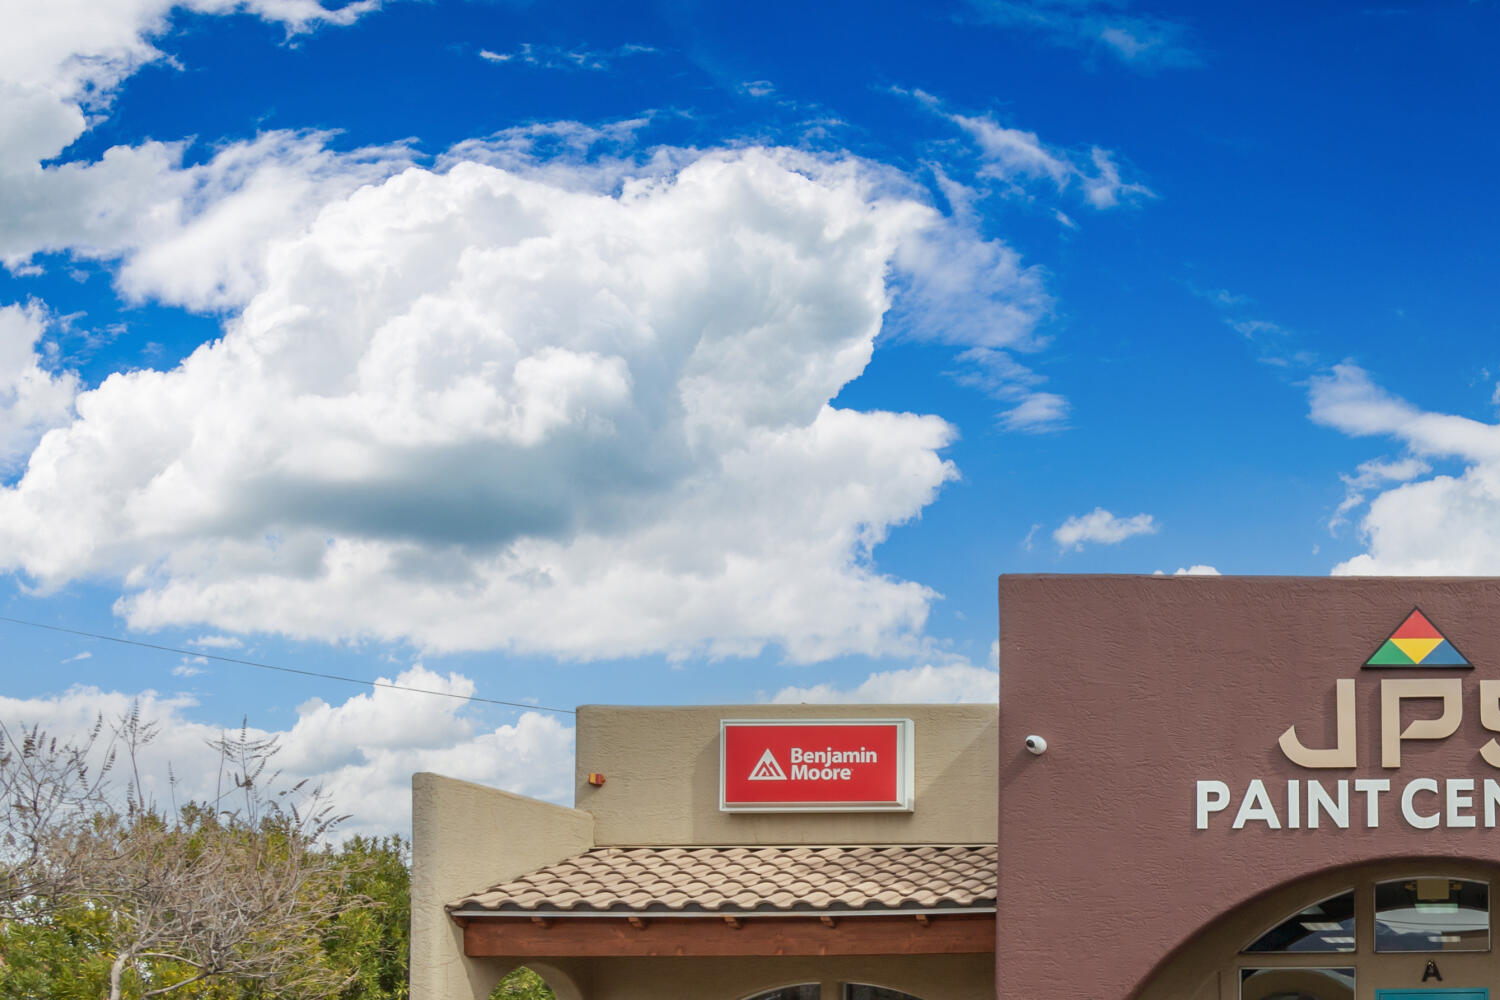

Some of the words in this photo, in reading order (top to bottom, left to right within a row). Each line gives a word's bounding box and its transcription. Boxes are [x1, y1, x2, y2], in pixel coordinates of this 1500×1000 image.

[790, 746, 878, 768] Benjamin
[790, 764, 852, 781] Moore
[1196, 778, 1390, 830] PAINT
[1421, 960, 1443, 983] A
